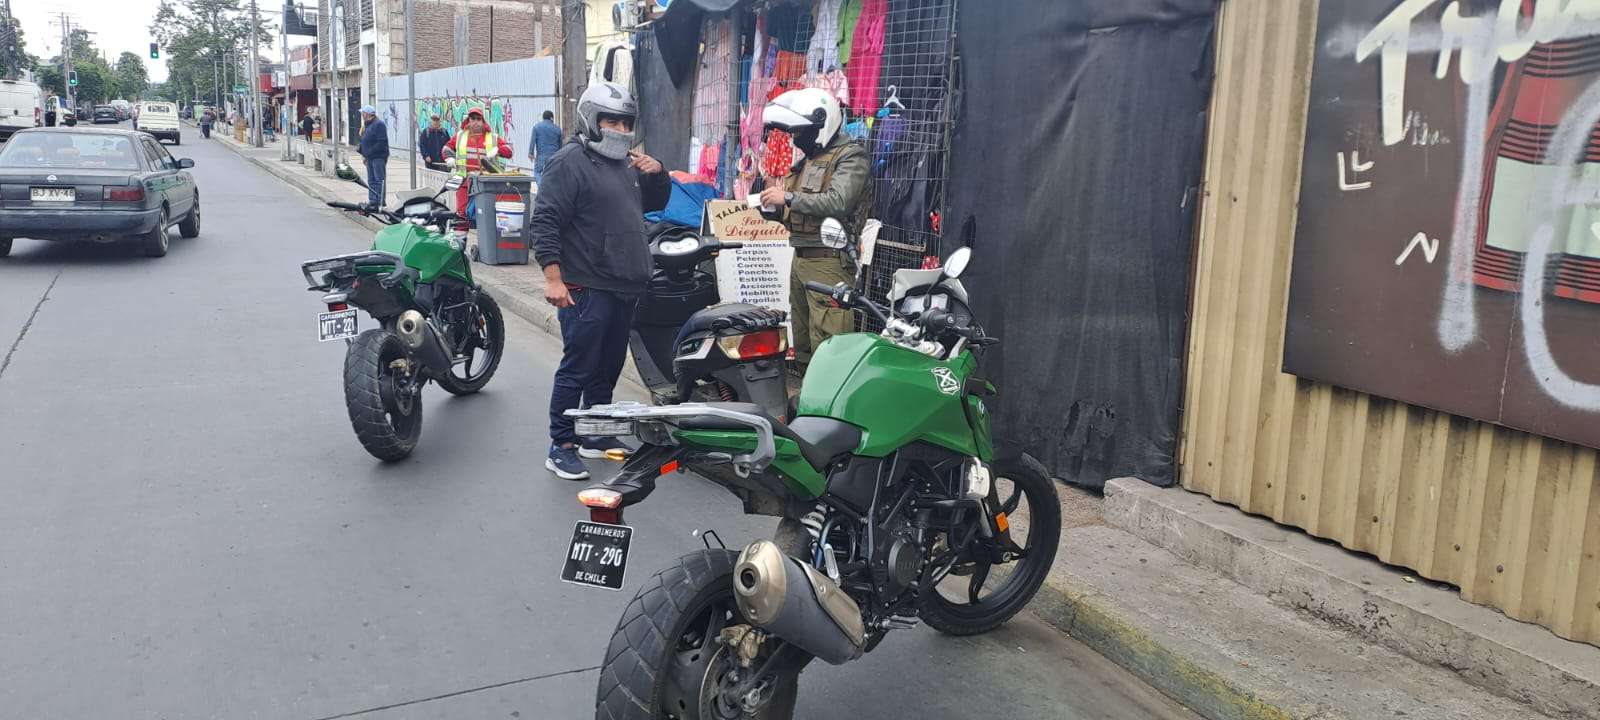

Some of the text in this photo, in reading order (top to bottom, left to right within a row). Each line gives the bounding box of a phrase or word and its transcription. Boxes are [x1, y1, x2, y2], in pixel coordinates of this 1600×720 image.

[580, 524, 626, 538] CARABINEROS
[575, 570, 607, 584] DE CHILE
